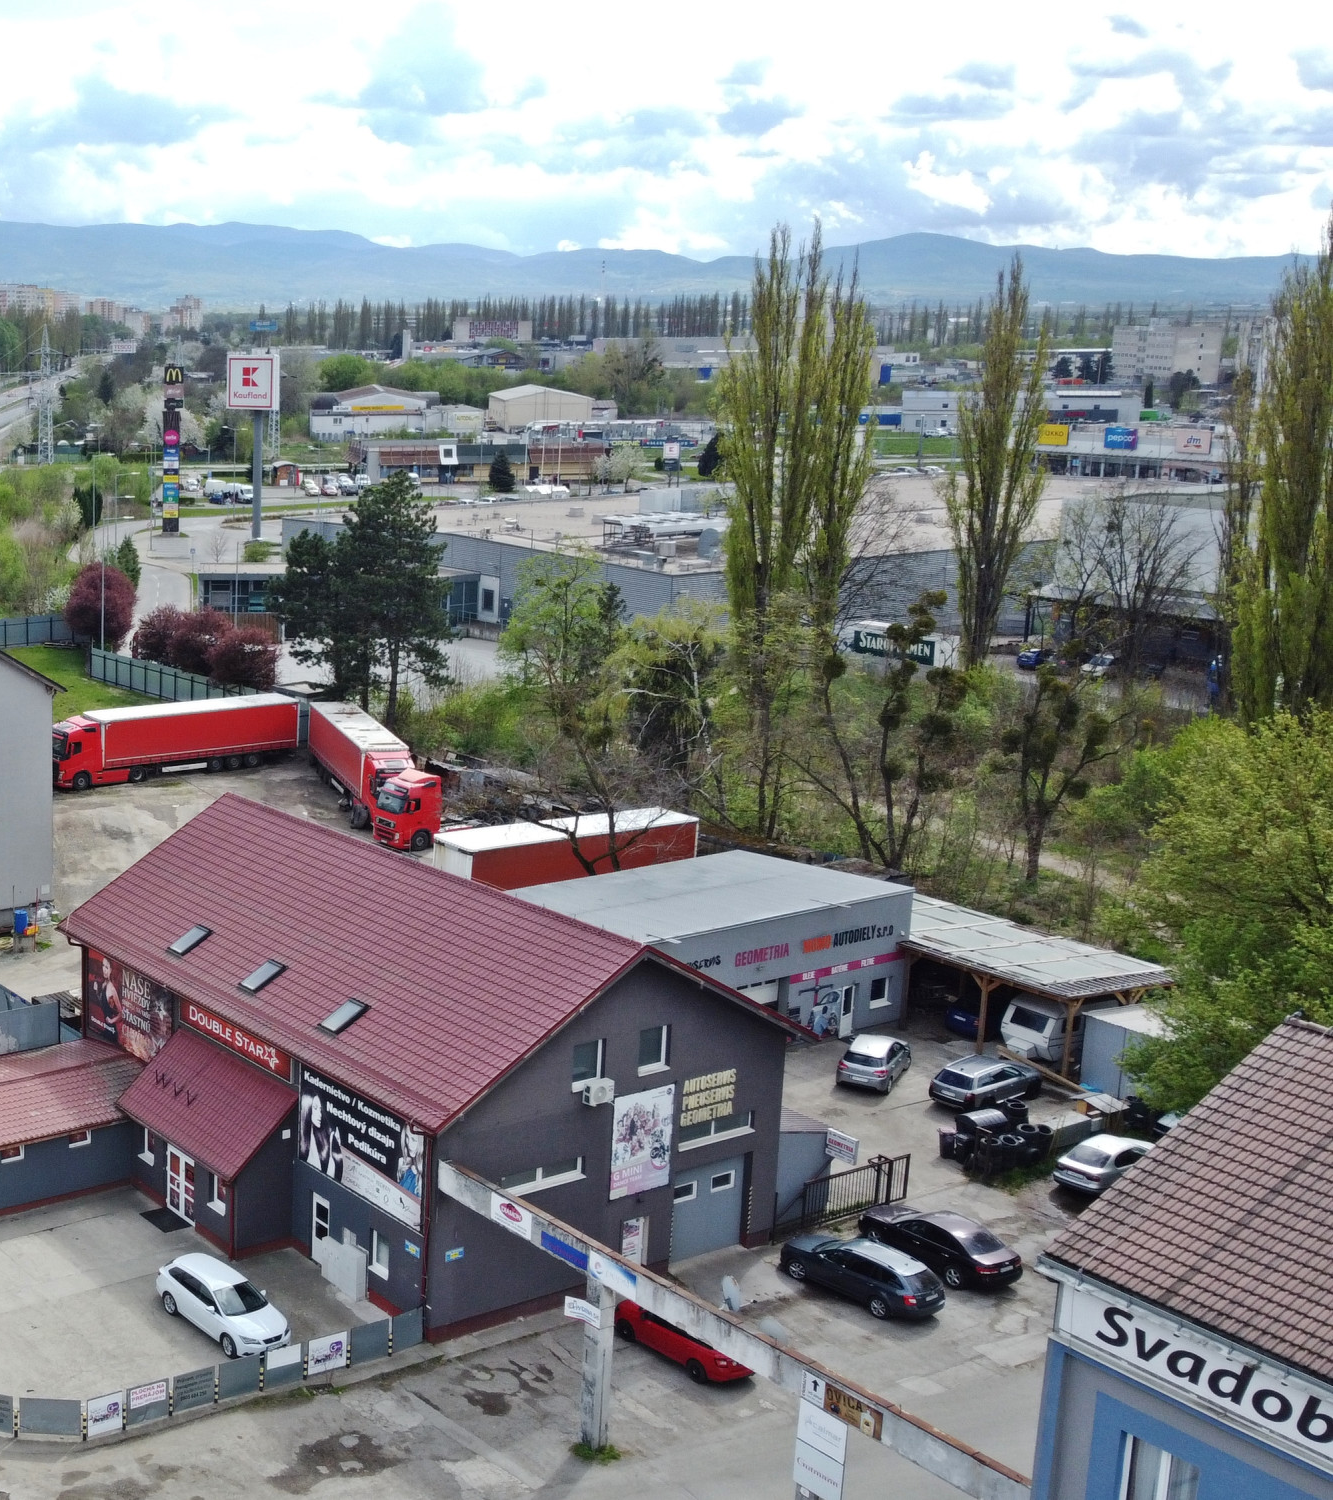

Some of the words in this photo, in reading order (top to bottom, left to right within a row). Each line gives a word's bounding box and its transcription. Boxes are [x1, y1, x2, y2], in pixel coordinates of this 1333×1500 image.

[233, 391, 268, 400] Kaufland
[1107, 433, 1135, 443] pepco
[1187, 435, 1201, 444] dm
[859, 631, 931, 657] STAROMEN
[833, 924, 876, 947] AUTODIELY
[735, 943, 790, 967] GEOMETRIA
[122, 986, 151, 1011] HVIEZDY
[189, 1005, 232, 1042] DOUBLE
[234, 1031, 264, 1059] STAR
[683, 1068, 737, 1094] AUTOSERVIS
[682, 1084, 735, 1111] PNEUSERVIS
[326, 1101, 367, 1134] Nechtový
[368, 1126, 395, 1149] dizajn
[357, 1100, 401, 1132] Kozmetika
[680, 1101, 733, 1127] GEOMETRIA
[347, 1133, 387, 1165] Pedikúra
[622, 1164, 643, 1178] MINI
[1095, 1306, 1333, 1443] Svadob
[131, 1385, 155, 1396] PLOCHA
